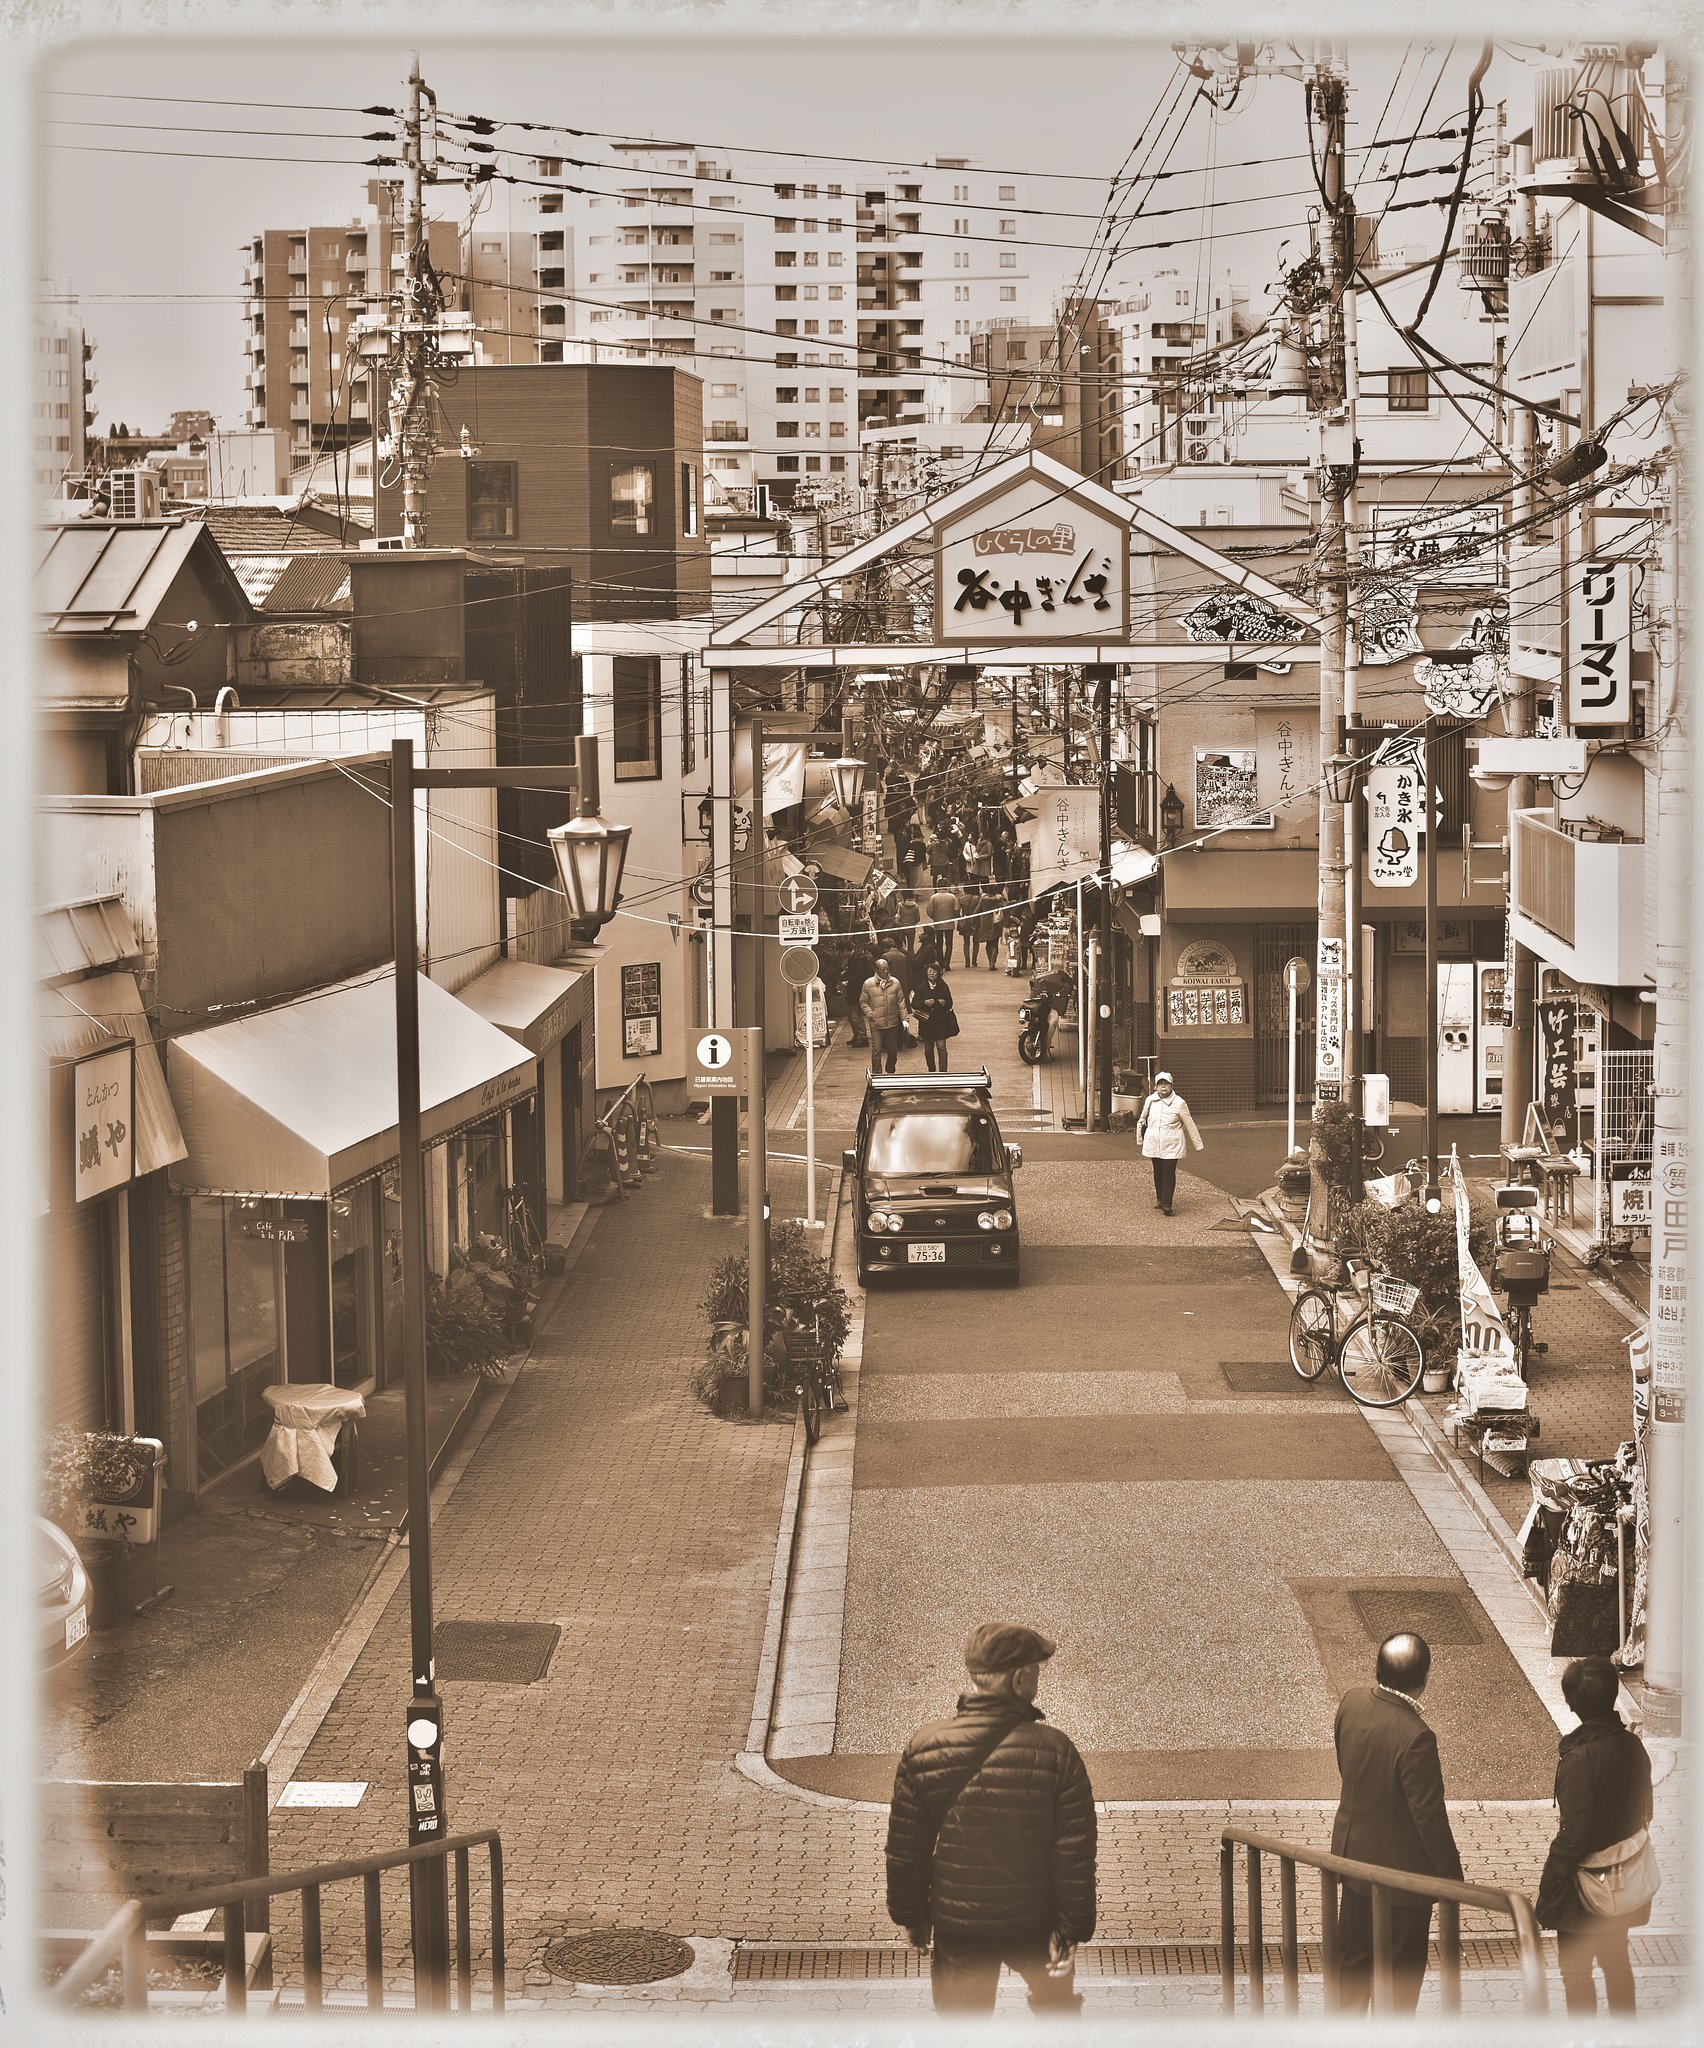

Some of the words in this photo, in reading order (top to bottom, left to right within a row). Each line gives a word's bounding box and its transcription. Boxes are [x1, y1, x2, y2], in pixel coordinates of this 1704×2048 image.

[975, 523, 1076, 556] ひぐらしの里
[953, 548, 1111, 625] 谷中ぎんざ
[1277, 721, 1294, 808] 谷中ぎんざ
[1397, 774, 1412, 823] かき氷
[1056, 797, 1070, 872] 谷中ぎんざ
[1374, 865, 1412, 878] ひみつ堂
[781, 918, 815, 927] 自転車を除く
[782, 927, 815, 935] 一方通行
[1548, 1009, 1569, 1089] 竹工芸
[86, 1081, 119, 1107] とんかつ
[256, 1221, 273, 1231] Café
[916, 1251, 944, 1261] 75-36
